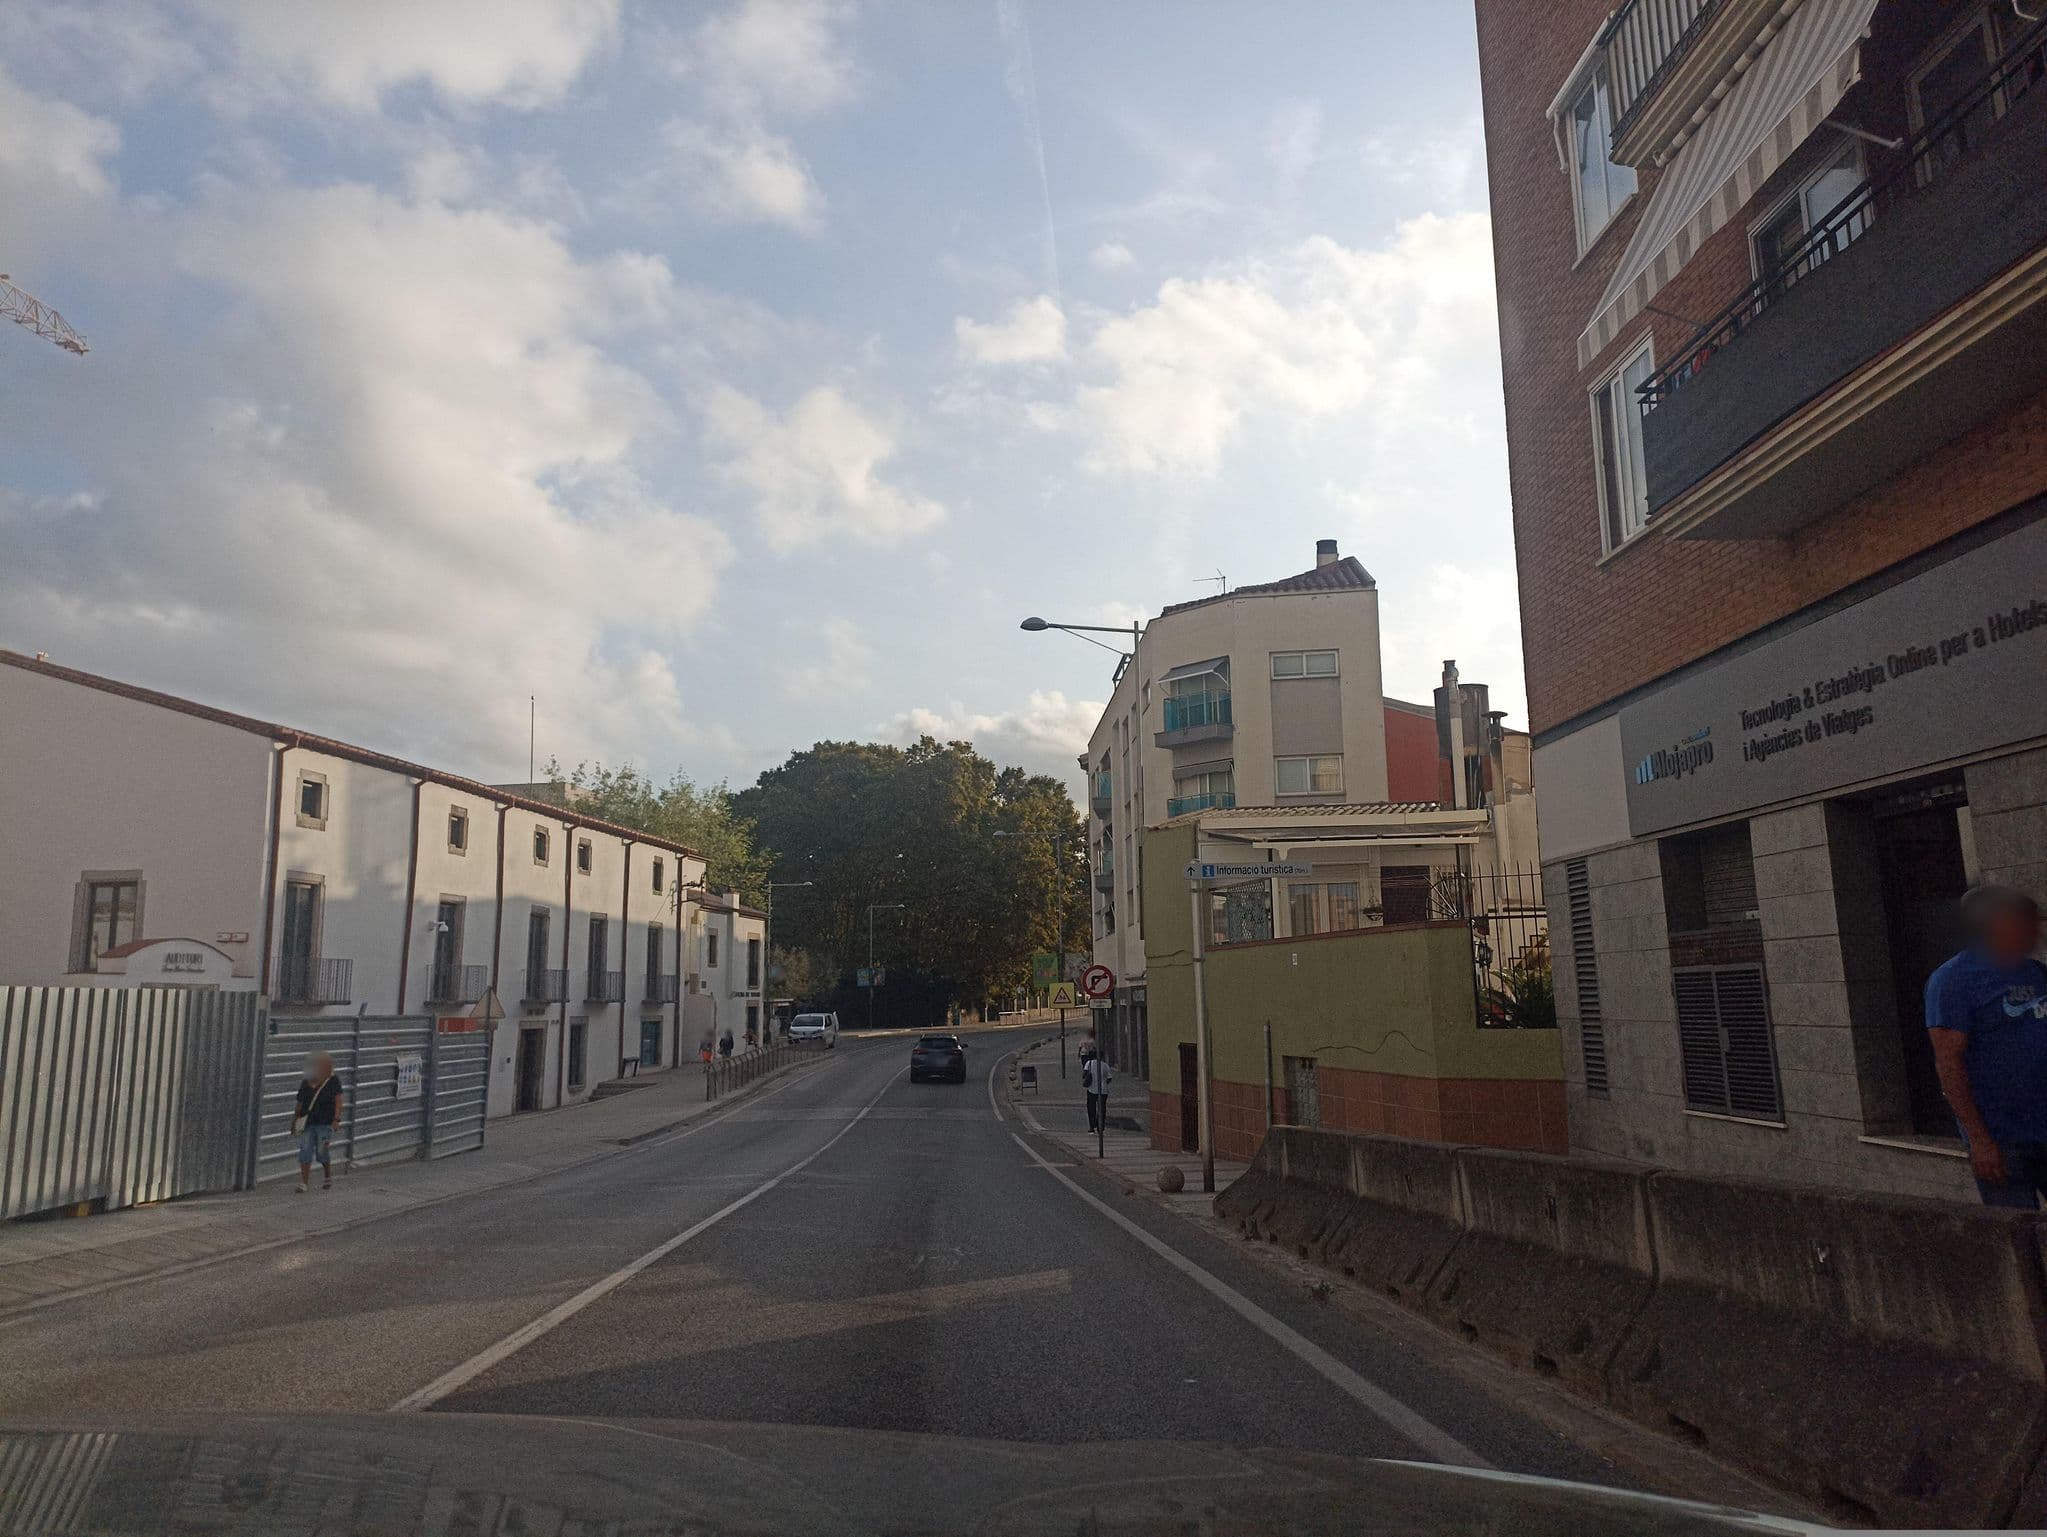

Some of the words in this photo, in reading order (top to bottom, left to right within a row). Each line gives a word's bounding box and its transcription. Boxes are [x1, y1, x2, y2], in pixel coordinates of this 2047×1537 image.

[1738, 693, 1802, 731] Tecnologia
[1803, 687, 1815, 709] &
[1887, 646, 1938, 679] Online
[1940, 632, 1969, 666] per
[1972, 627, 1987, 648] a
[1743, 742, 1750, 762] i
[1804, 720, 1822, 743] de
[1821, 706, 1874, 736] Viatges
